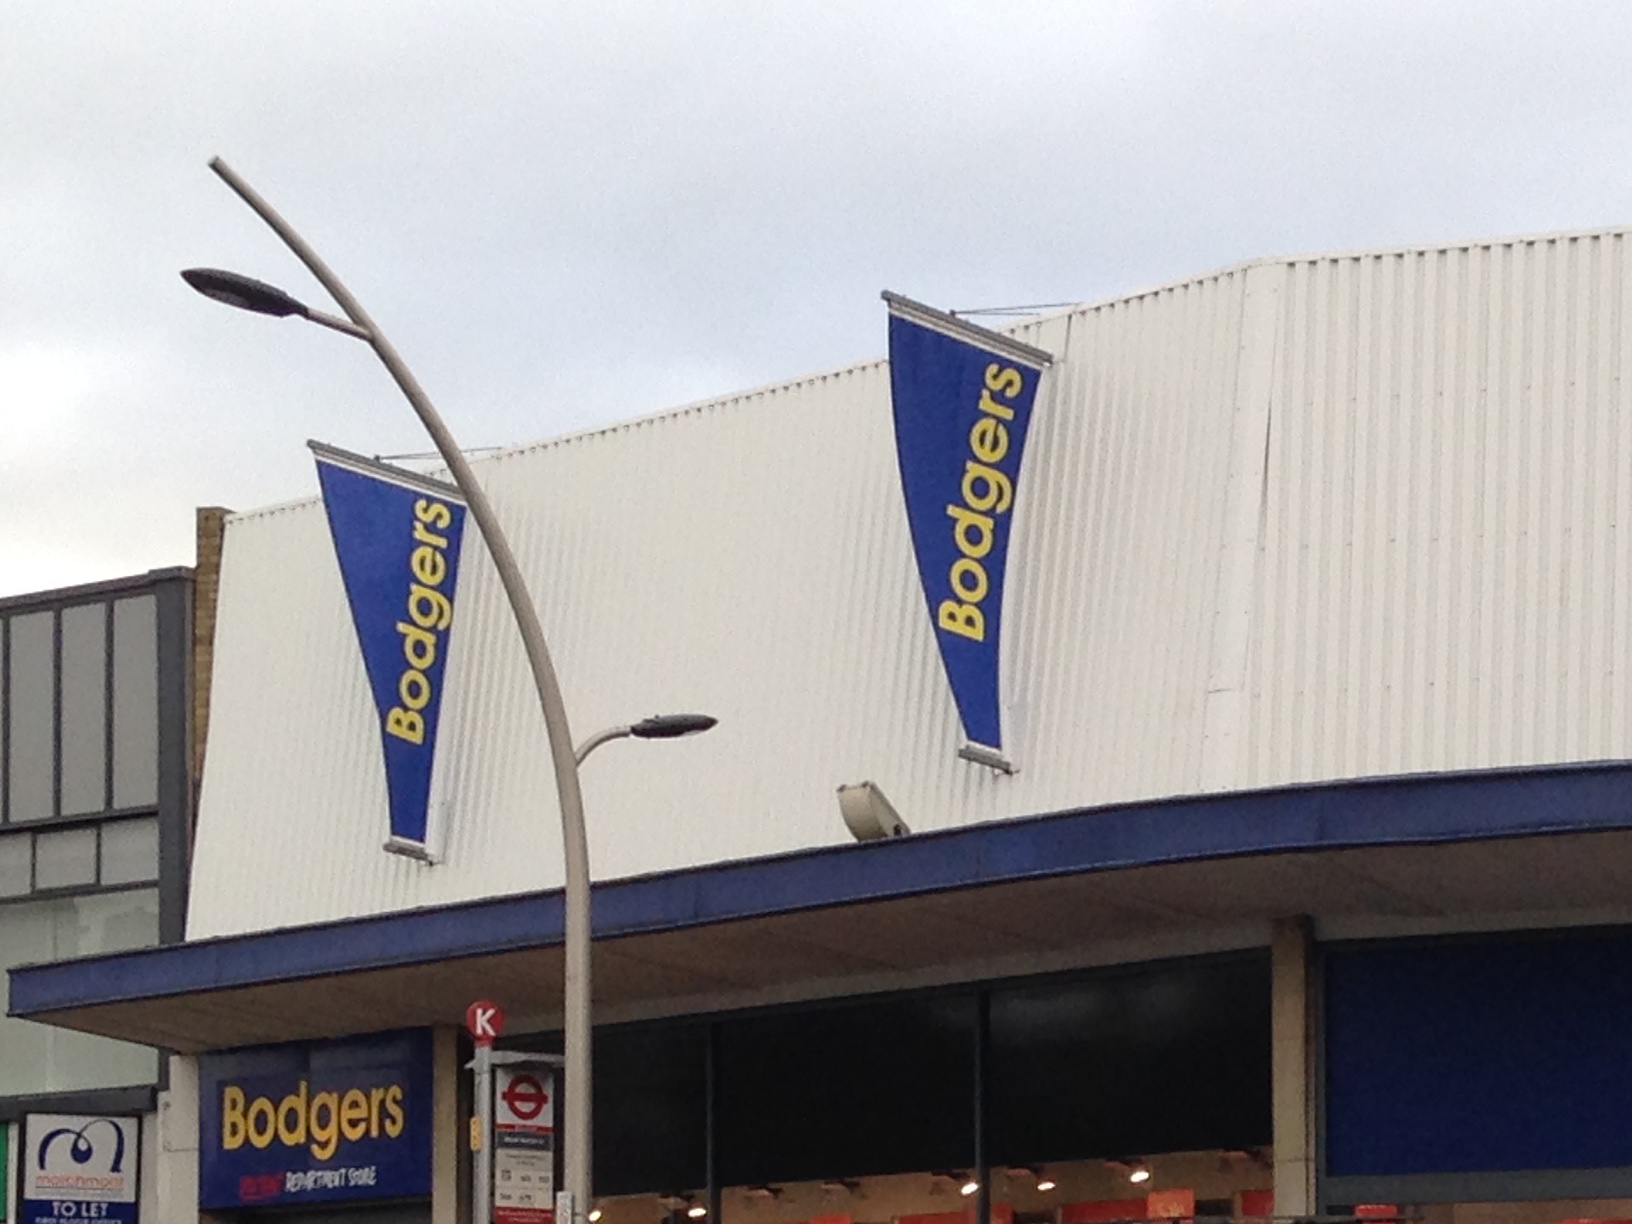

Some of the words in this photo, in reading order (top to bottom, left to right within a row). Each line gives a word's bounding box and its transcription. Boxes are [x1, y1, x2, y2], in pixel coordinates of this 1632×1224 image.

[937, 361, 1023, 642] Bodgers
[385, 498, 453, 745] Bodgers
[475, 1007, 497, 1037] K
[222, 1079, 406, 1162] Bodgers
[52, 1201, 77, 1217] TO
[81, 1202, 109, 1218] LET
